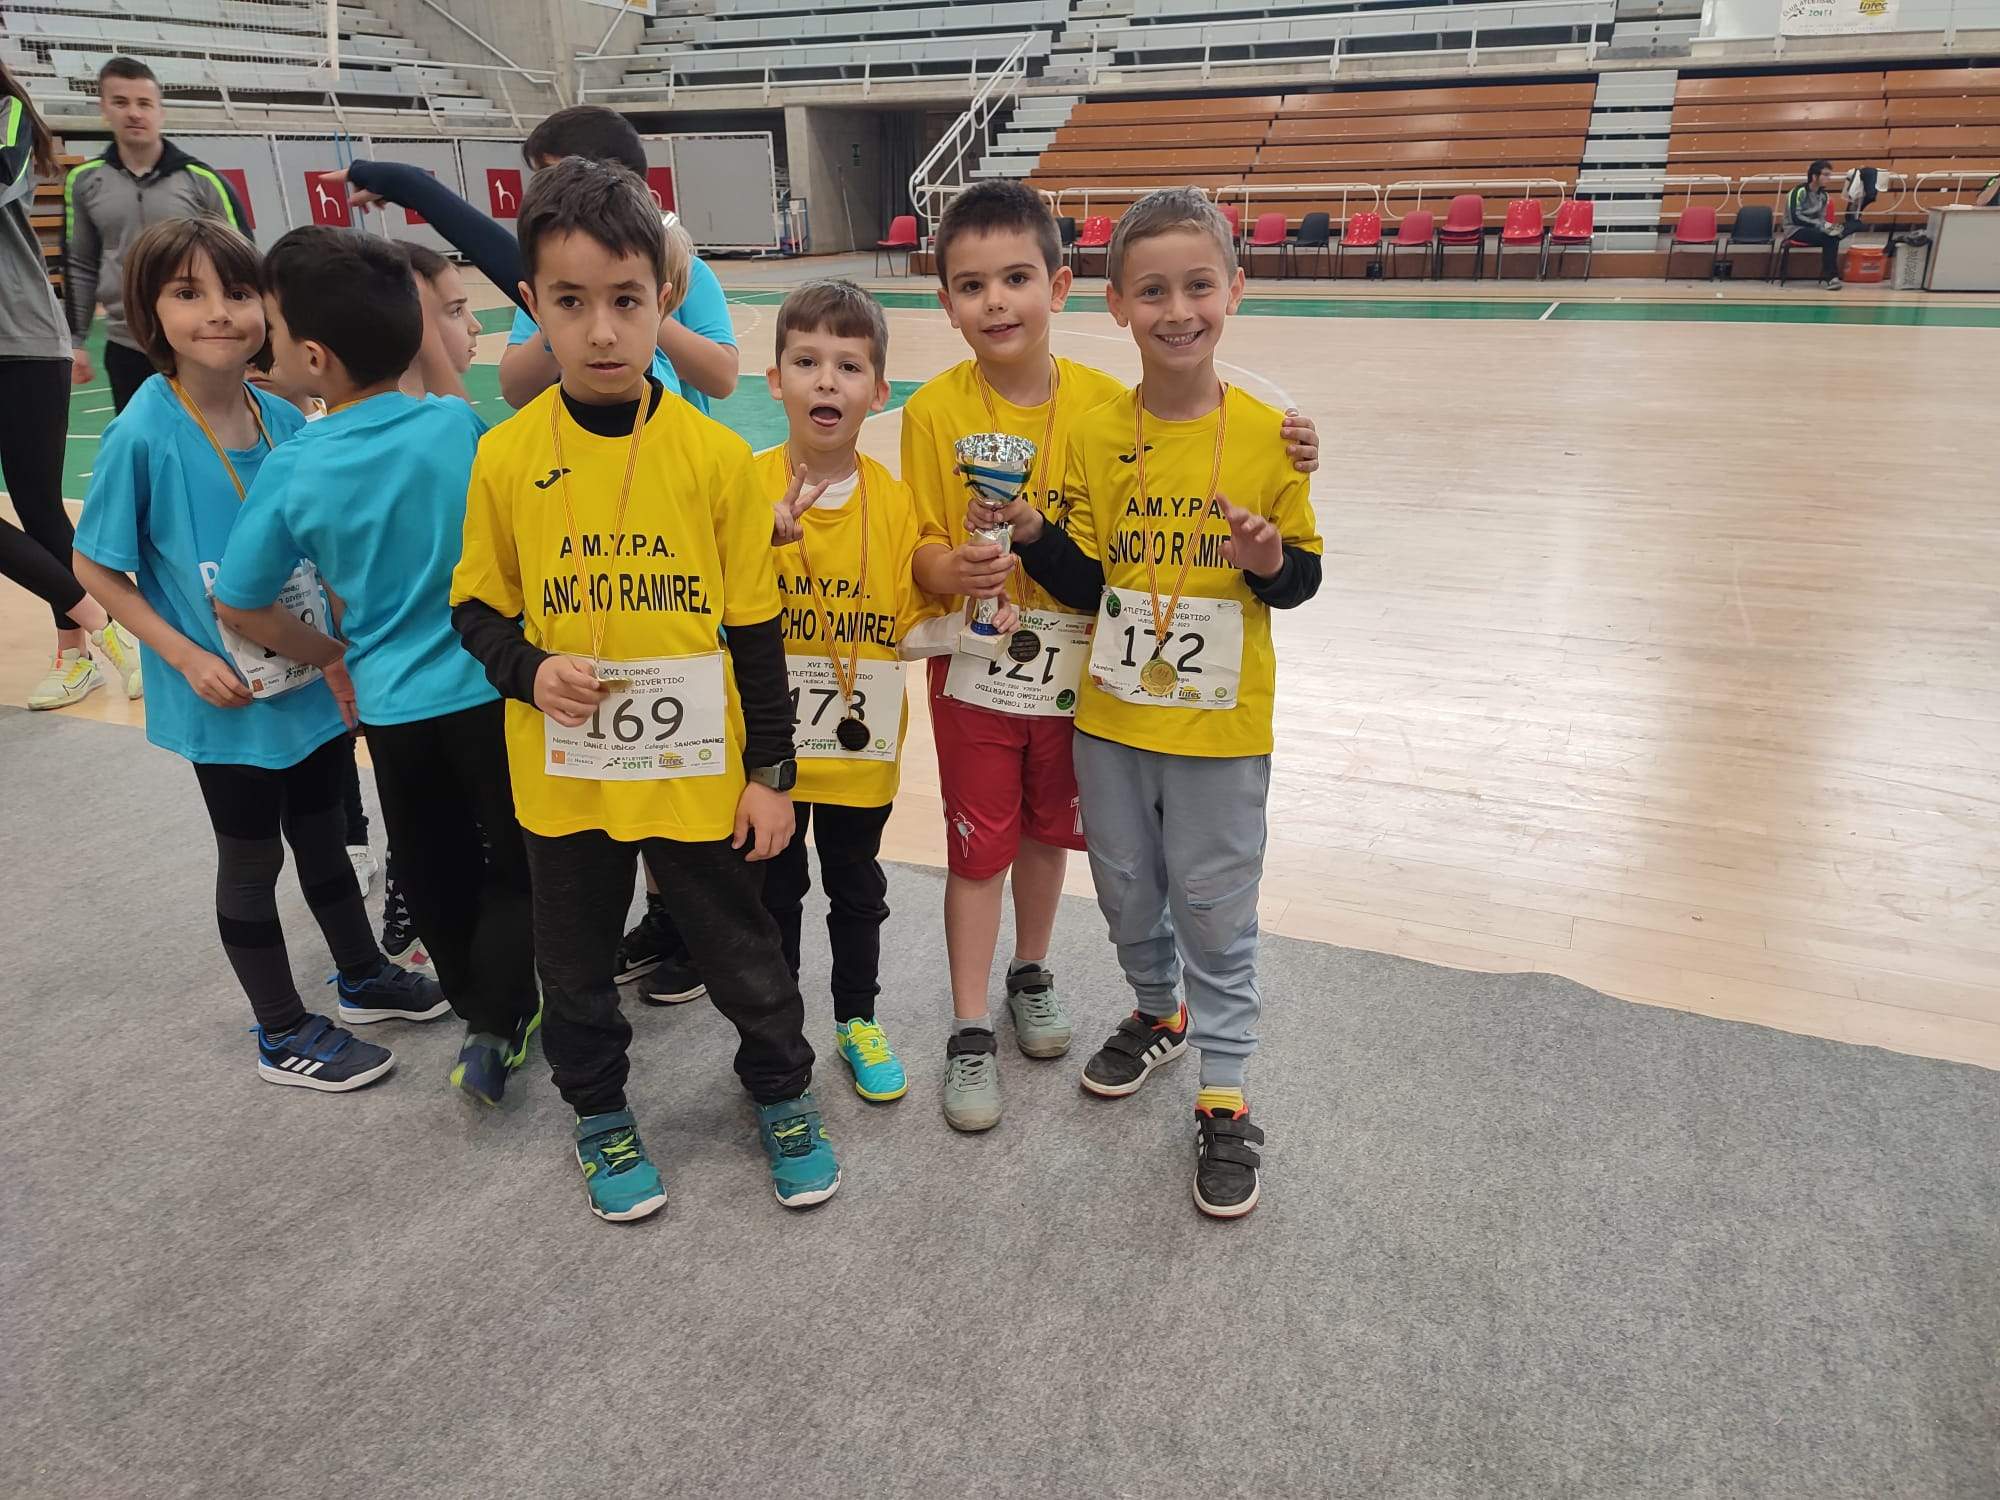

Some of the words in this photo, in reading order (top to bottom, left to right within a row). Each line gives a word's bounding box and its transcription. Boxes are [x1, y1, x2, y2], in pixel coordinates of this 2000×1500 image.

[1126, 496, 1226, 519] A.M.Y.PA.
[560, 534, 675, 558] AM.Y.P.A.
[1108, 530, 1166, 565] SNCHO
[543, 573, 613, 616] ANCHO
[778, 574, 871, 599] A.MY.P.A.
[780, 607, 816, 642] CHO
[1123, 607, 1164, 617] ATLETISO
[1172, 613, 1211, 621] IVERTIDO
[1120, 625, 1205, 674] 172
[603, 668, 619, 676] XVI
[623, 667, 661, 676] TORNEO
[635, 676, 685, 687] DIVERTIDO
[975, 683, 1015, 697] DIVERTIDO
[992, 698, 1020, 708] TORNEO
[586, 697, 684, 743] 169
